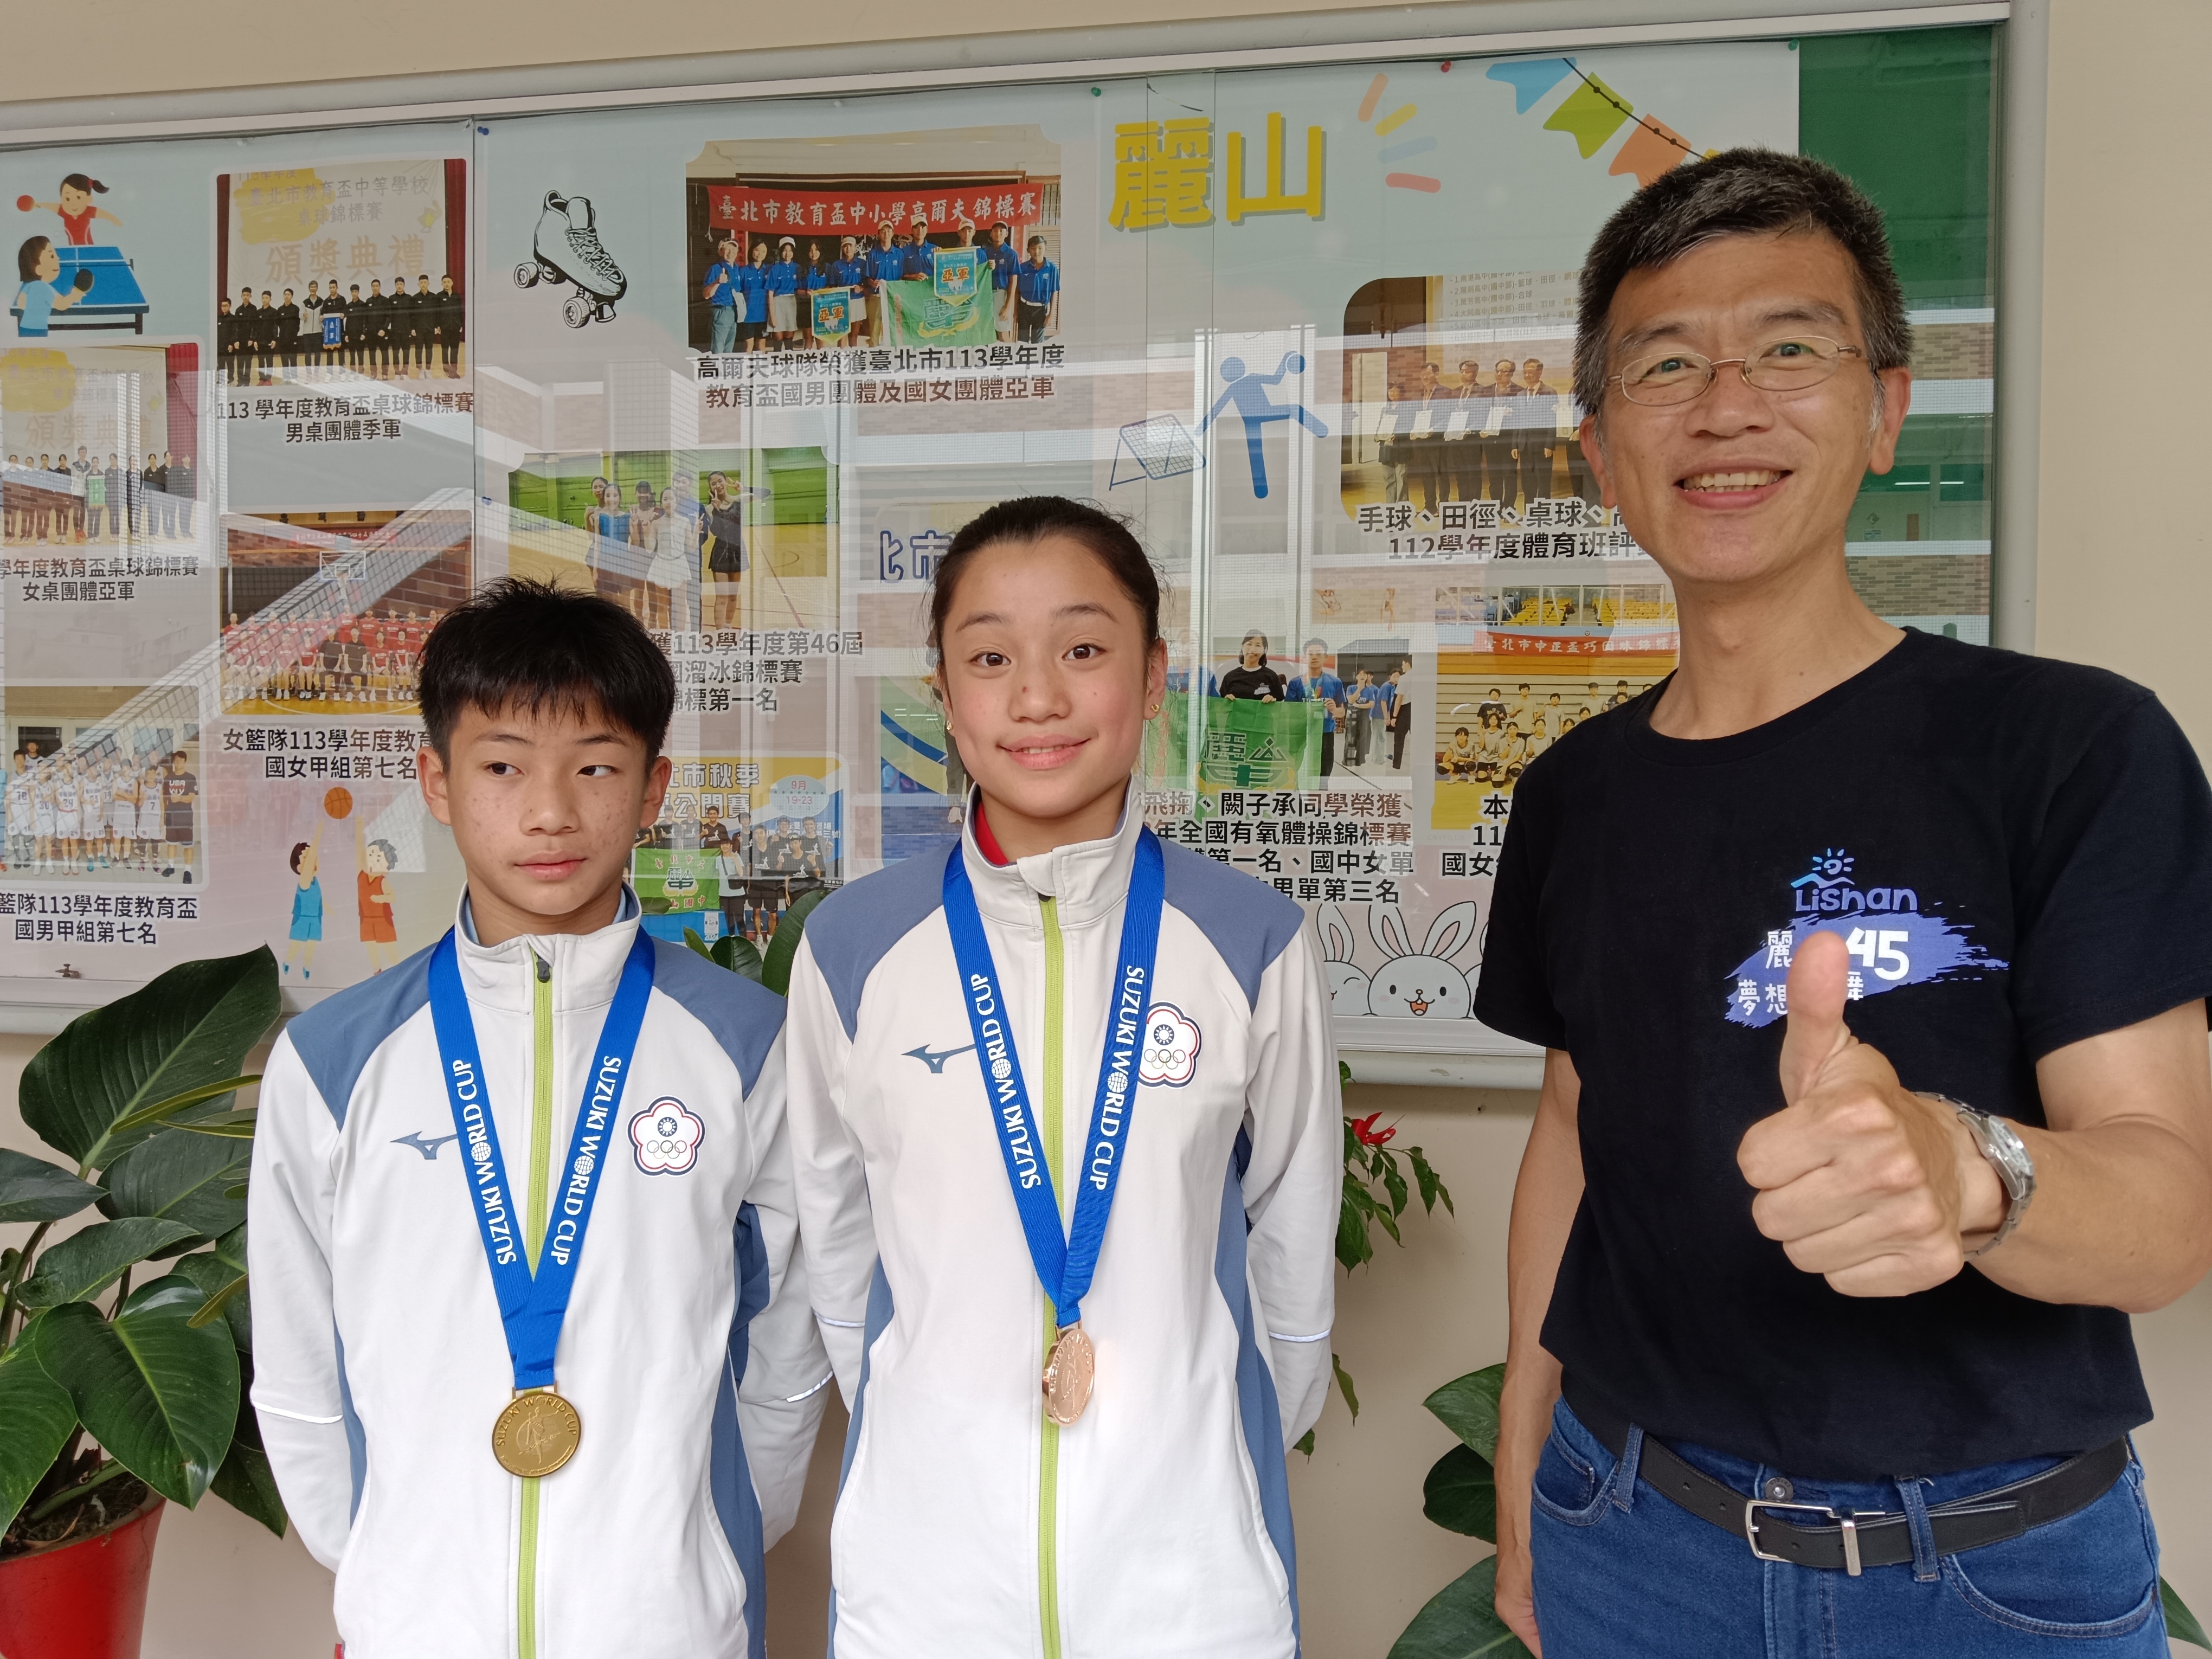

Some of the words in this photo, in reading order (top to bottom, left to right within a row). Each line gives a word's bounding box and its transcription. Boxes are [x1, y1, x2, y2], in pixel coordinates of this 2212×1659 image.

[1108, 112, 1325, 230] 麗山
[718, 191, 1036, 227] 臺北市教育盃中小學高爾夫錦標賽
[265, 233, 425, 286] 頒獎典禮
[697, 343, 1065, 381] 高爾夫球隊榮獲臺北市113學年度
[217, 401, 249, 420] 113
[255, 392, 474, 420] 學年度教育盃桌球錦標賽
[706, 373, 1055, 409] 教育盃國男團體及國女團體亞軍
[285, 419, 401, 443] 男桌團體季軍
[1358, 500, 1623, 532] 手球、田徑、桌球、
[1389, 530, 1647, 561] 112學年度體育班評
[23, 581, 135, 602] 女桌團體亞軍
[265, 755, 417, 780] 國女甲組第七名
[786, 795, 813, 805] 19-23
[791, 780, 806, 790] 9月
[1139, 791, 1412, 817] 飛掬、闕子承同學榮獲、
[1483, 794, 1509, 819] 本
[1188, 847, 1413, 876] 第一名、國中女單
[1442, 852, 1494, 877] 國女
[0, 892, 197, 919] 籃隊113學年度教育盃
[1256, 877, 1399, 904] 男單第三名
[15, 919, 157, 946] 國男甲組第七名
[1765, 930, 1793, 969] 麗
[1846, 927, 1909, 981] 45
[970, 973, 995, 1015] CUP
[1116, 964, 1144, 1046] SUZUKI
[453, 1059, 478, 1101] CUP
[586, 1056, 621, 1131] SUZUKI
[1003, 1104, 1041, 1189] SUZUKI
[1090, 1141, 1115, 1191] CUP
[481, 1185, 517, 1265] SUZUKI
[551, 1219, 576, 1266] CUP
[496, 1405, 520, 1446] SUZUKI
[564, 1412, 577, 1436] CUP
